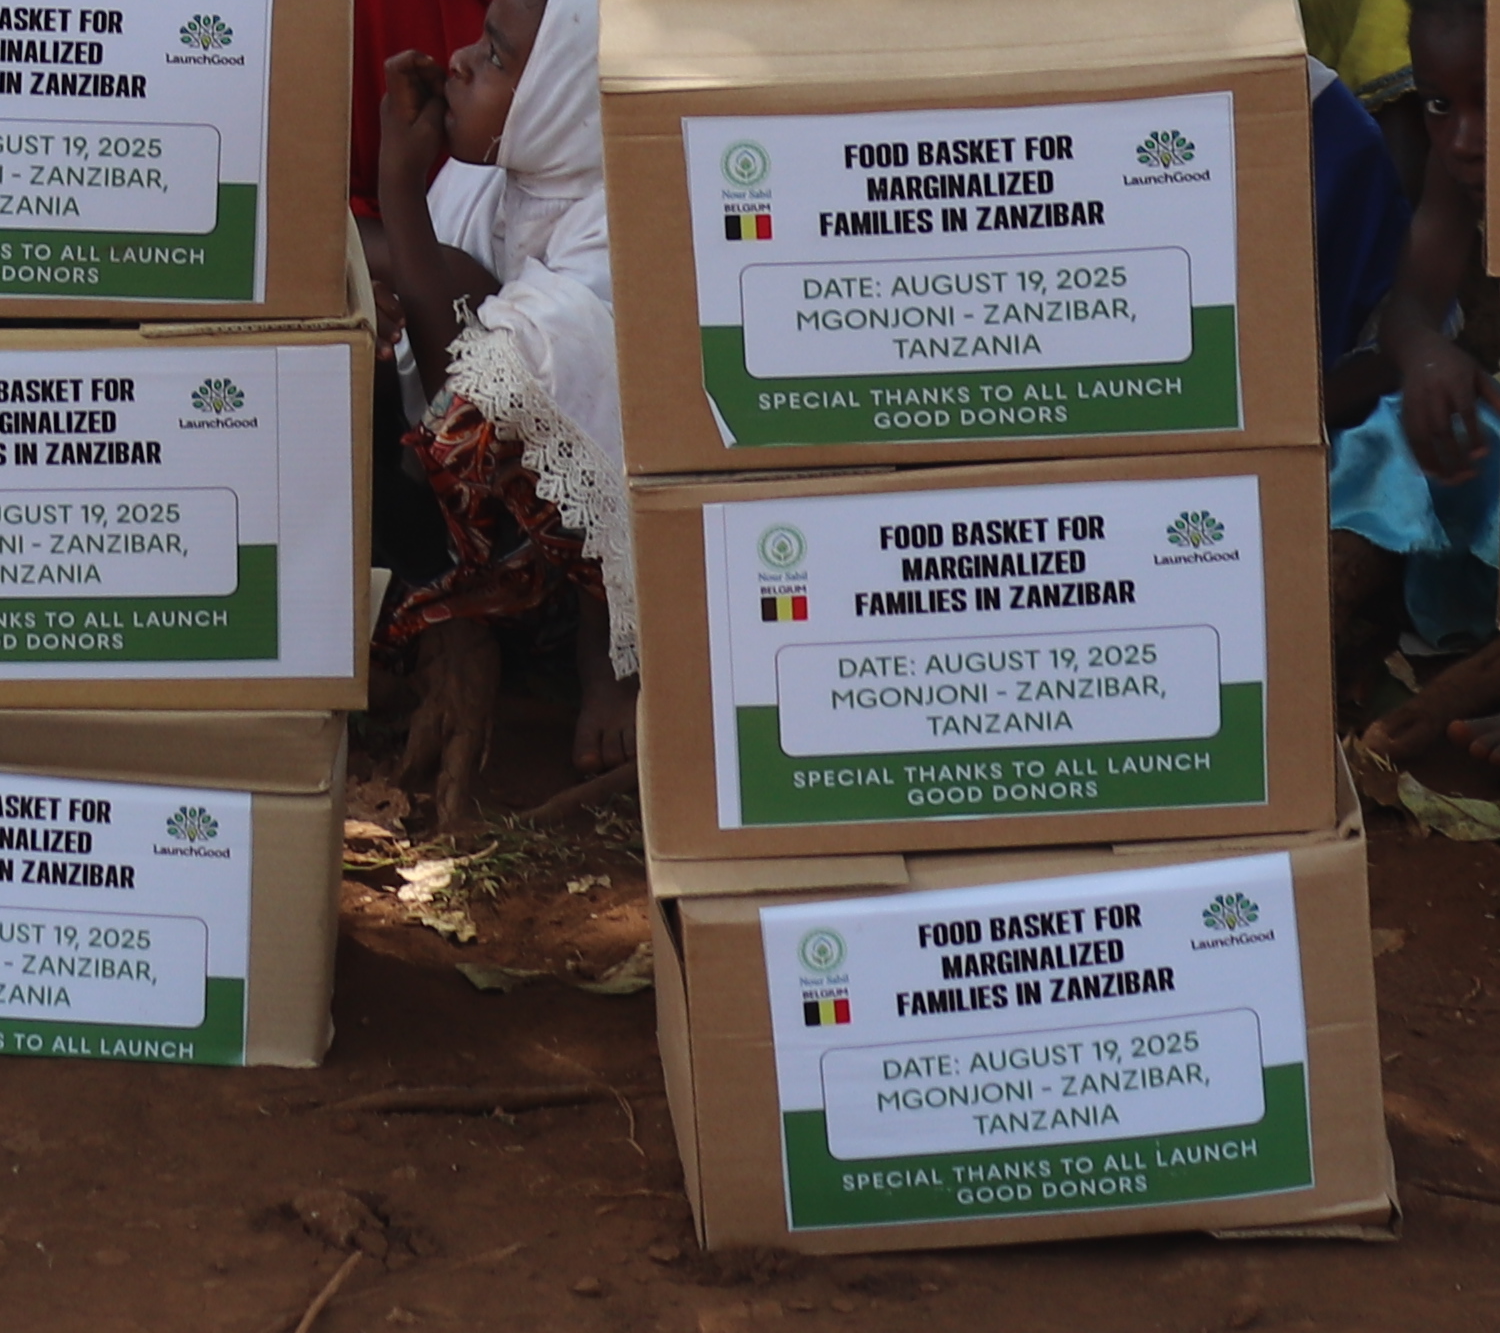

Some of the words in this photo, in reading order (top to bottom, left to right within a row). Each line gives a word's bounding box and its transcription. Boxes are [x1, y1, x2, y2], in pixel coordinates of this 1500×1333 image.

[79, 9, 124, 34] FOR
[166, 53, 246, 67] LaunchGood
[819, 207, 934, 237] FAMILIES
[940, 206, 967, 232] IN
[975, 200, 1105, 230] ZANZIBAR
[802, 276, 882, 301] DATE:
[889, 270, 1009, 297] AUGUST
[1017, 269, 1047, 295] 19,
[1055, 265, 1128, 290] 2025
[49, 533, 189, 558] ZANZIBAR,
[879, 523, 945, 550] FOOD
[951, 517, 1050, 547] BASKET
[1057, 515, 1106, 541] FOR
[1154, 550, 1241, 567] LaunchGood
[54, 924, 80, 950] 19,
[87, 926, 152, 950] 2025
[876, 1078, 1034, 1116] MGONJONI
[1059, 1060, 1211, 1101] ZANZIBAR,
[973, 1102, 1119, 1137] TANZANIA
